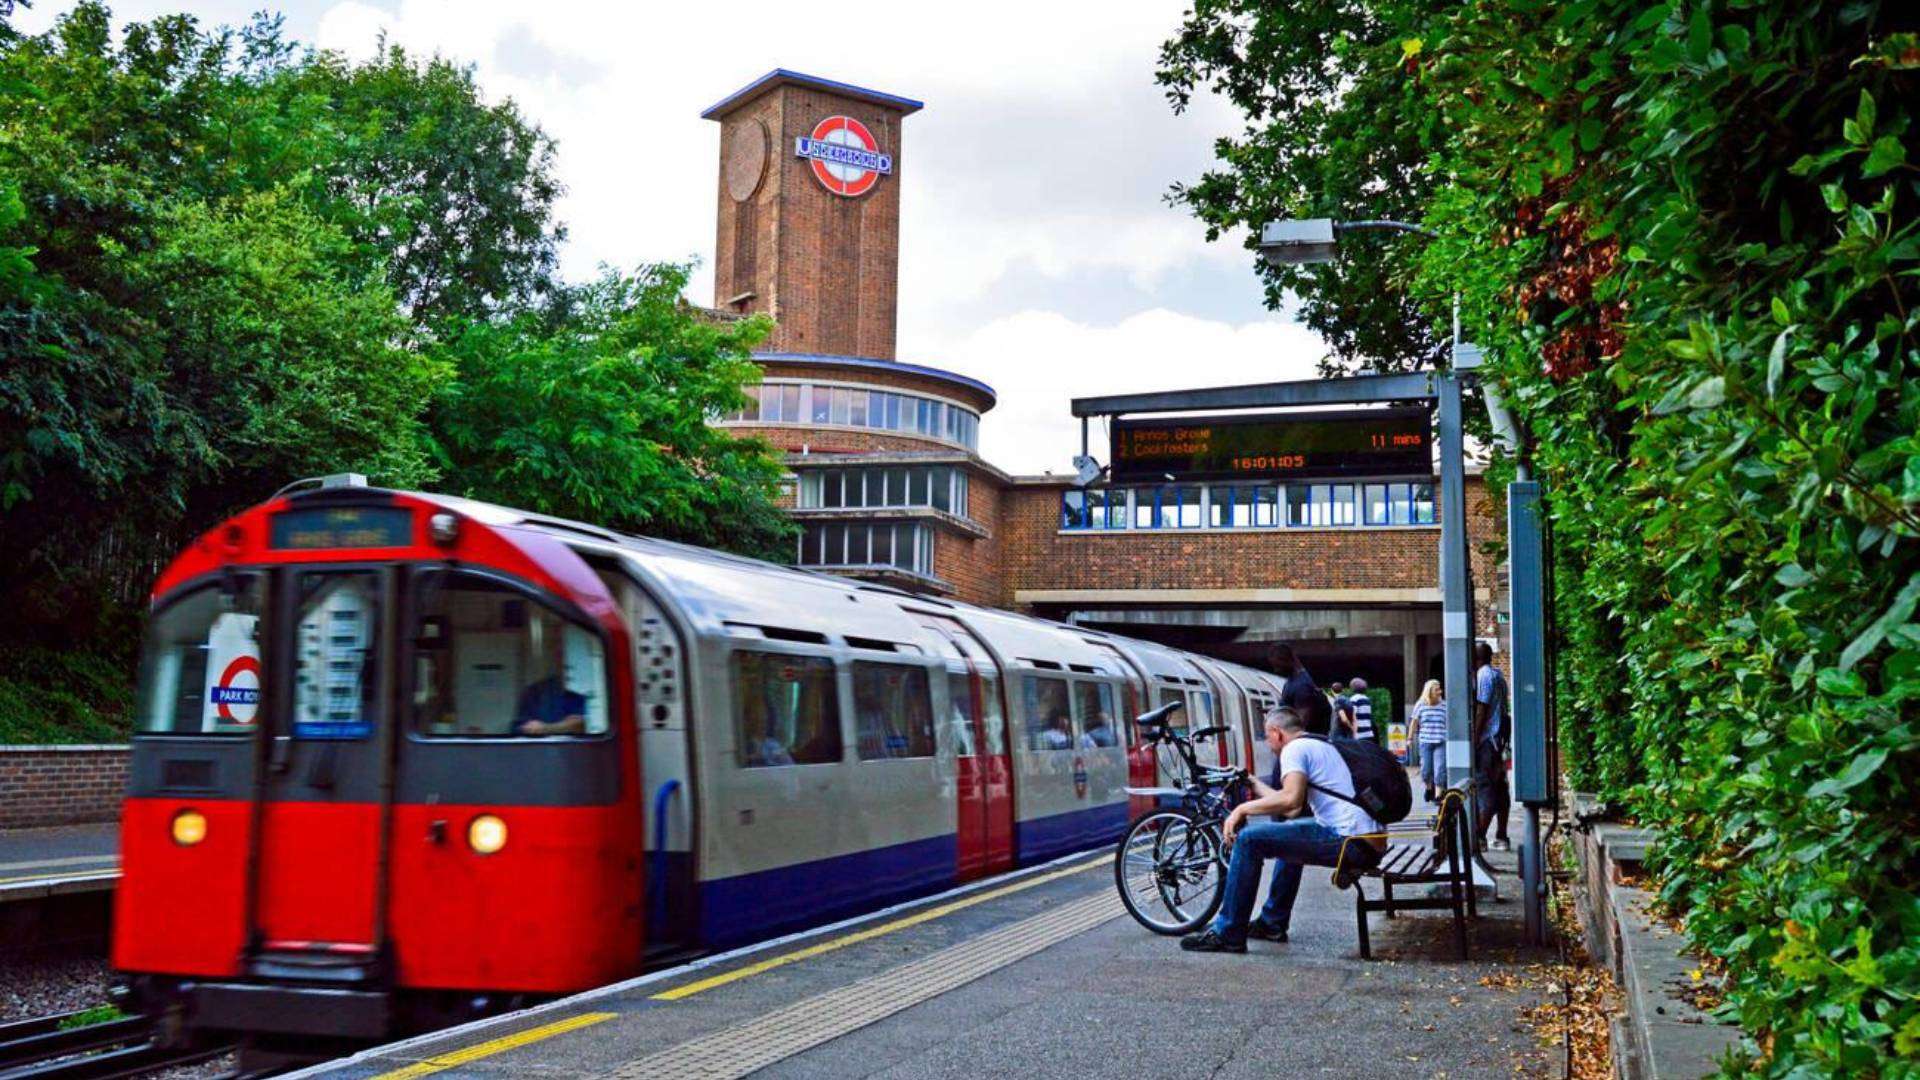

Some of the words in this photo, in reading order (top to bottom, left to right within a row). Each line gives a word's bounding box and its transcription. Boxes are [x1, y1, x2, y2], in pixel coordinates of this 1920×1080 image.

[796, 136, 892, 174] UNDERGROUND
[1371, 435, 1385, 448] 11
[1393, 433, 1421, 446] mins
[219, 688, 242, 701] PARK
